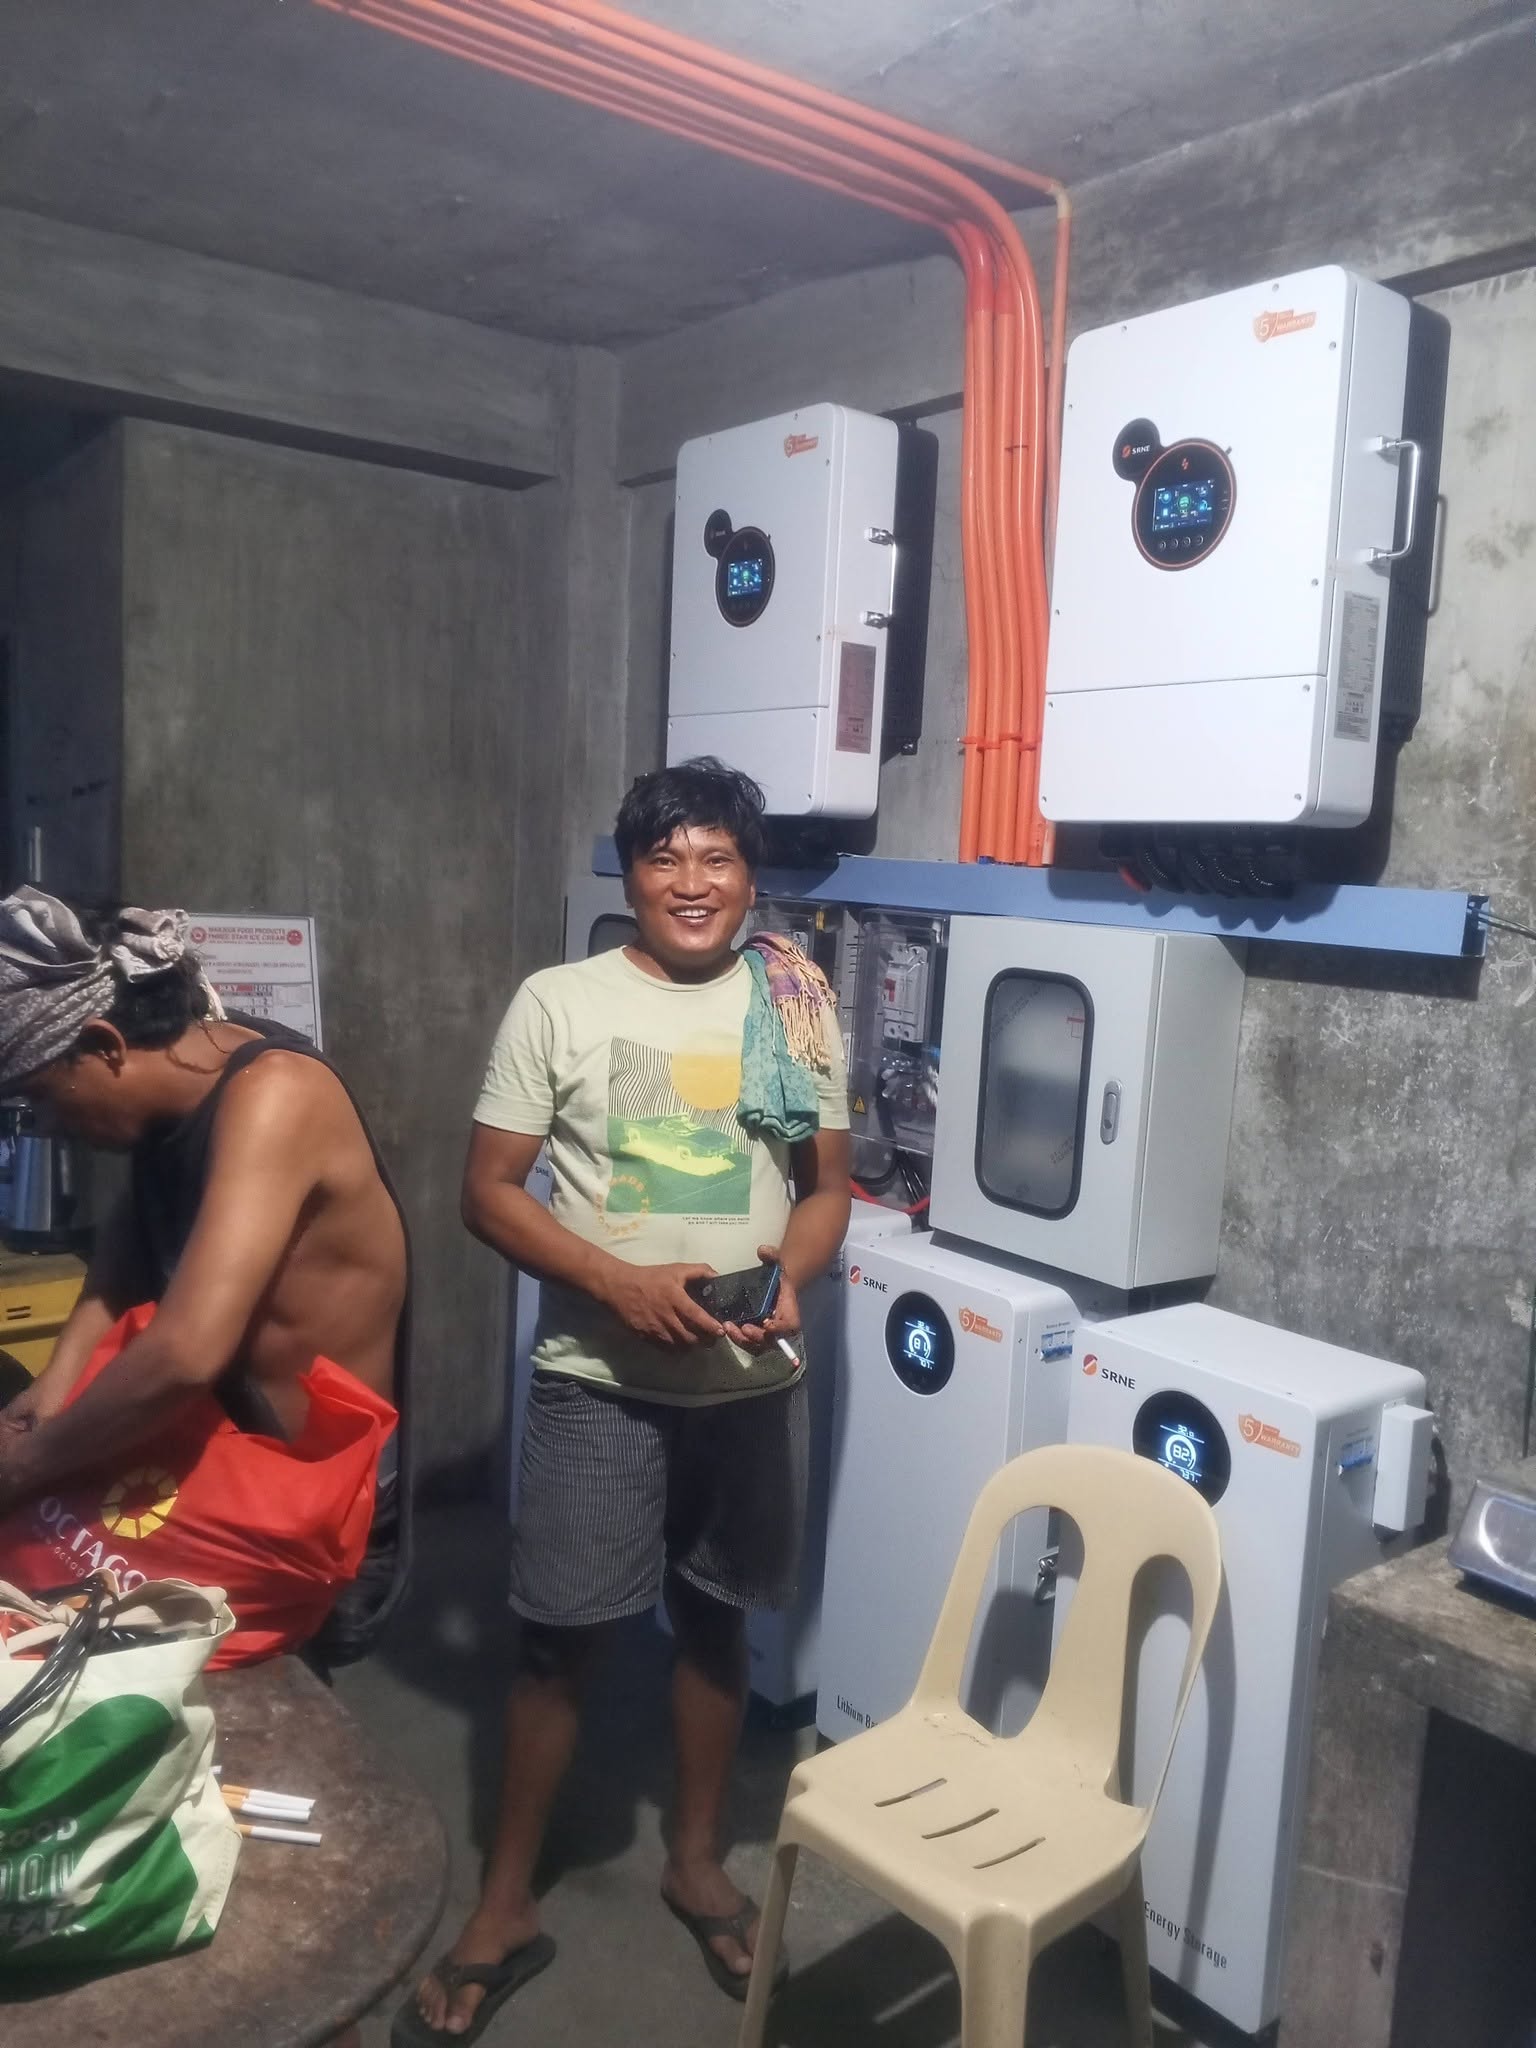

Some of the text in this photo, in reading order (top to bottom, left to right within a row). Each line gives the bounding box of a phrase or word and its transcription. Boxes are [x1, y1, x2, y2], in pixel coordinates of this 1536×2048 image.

[1132, 445, 1150, 455] SRNE
[863, 1277, 888, 1293] SRNE
[962, 1311, 970, 1327] 5
[1101, 1368, 1136, 1390] SRNE
[1243, 1417, 1300, 1456] 5 WARRANTY
[837, 1695, 863, 1724] Lithium
[1144, 1901, 1227, 1969] Energy Storage
